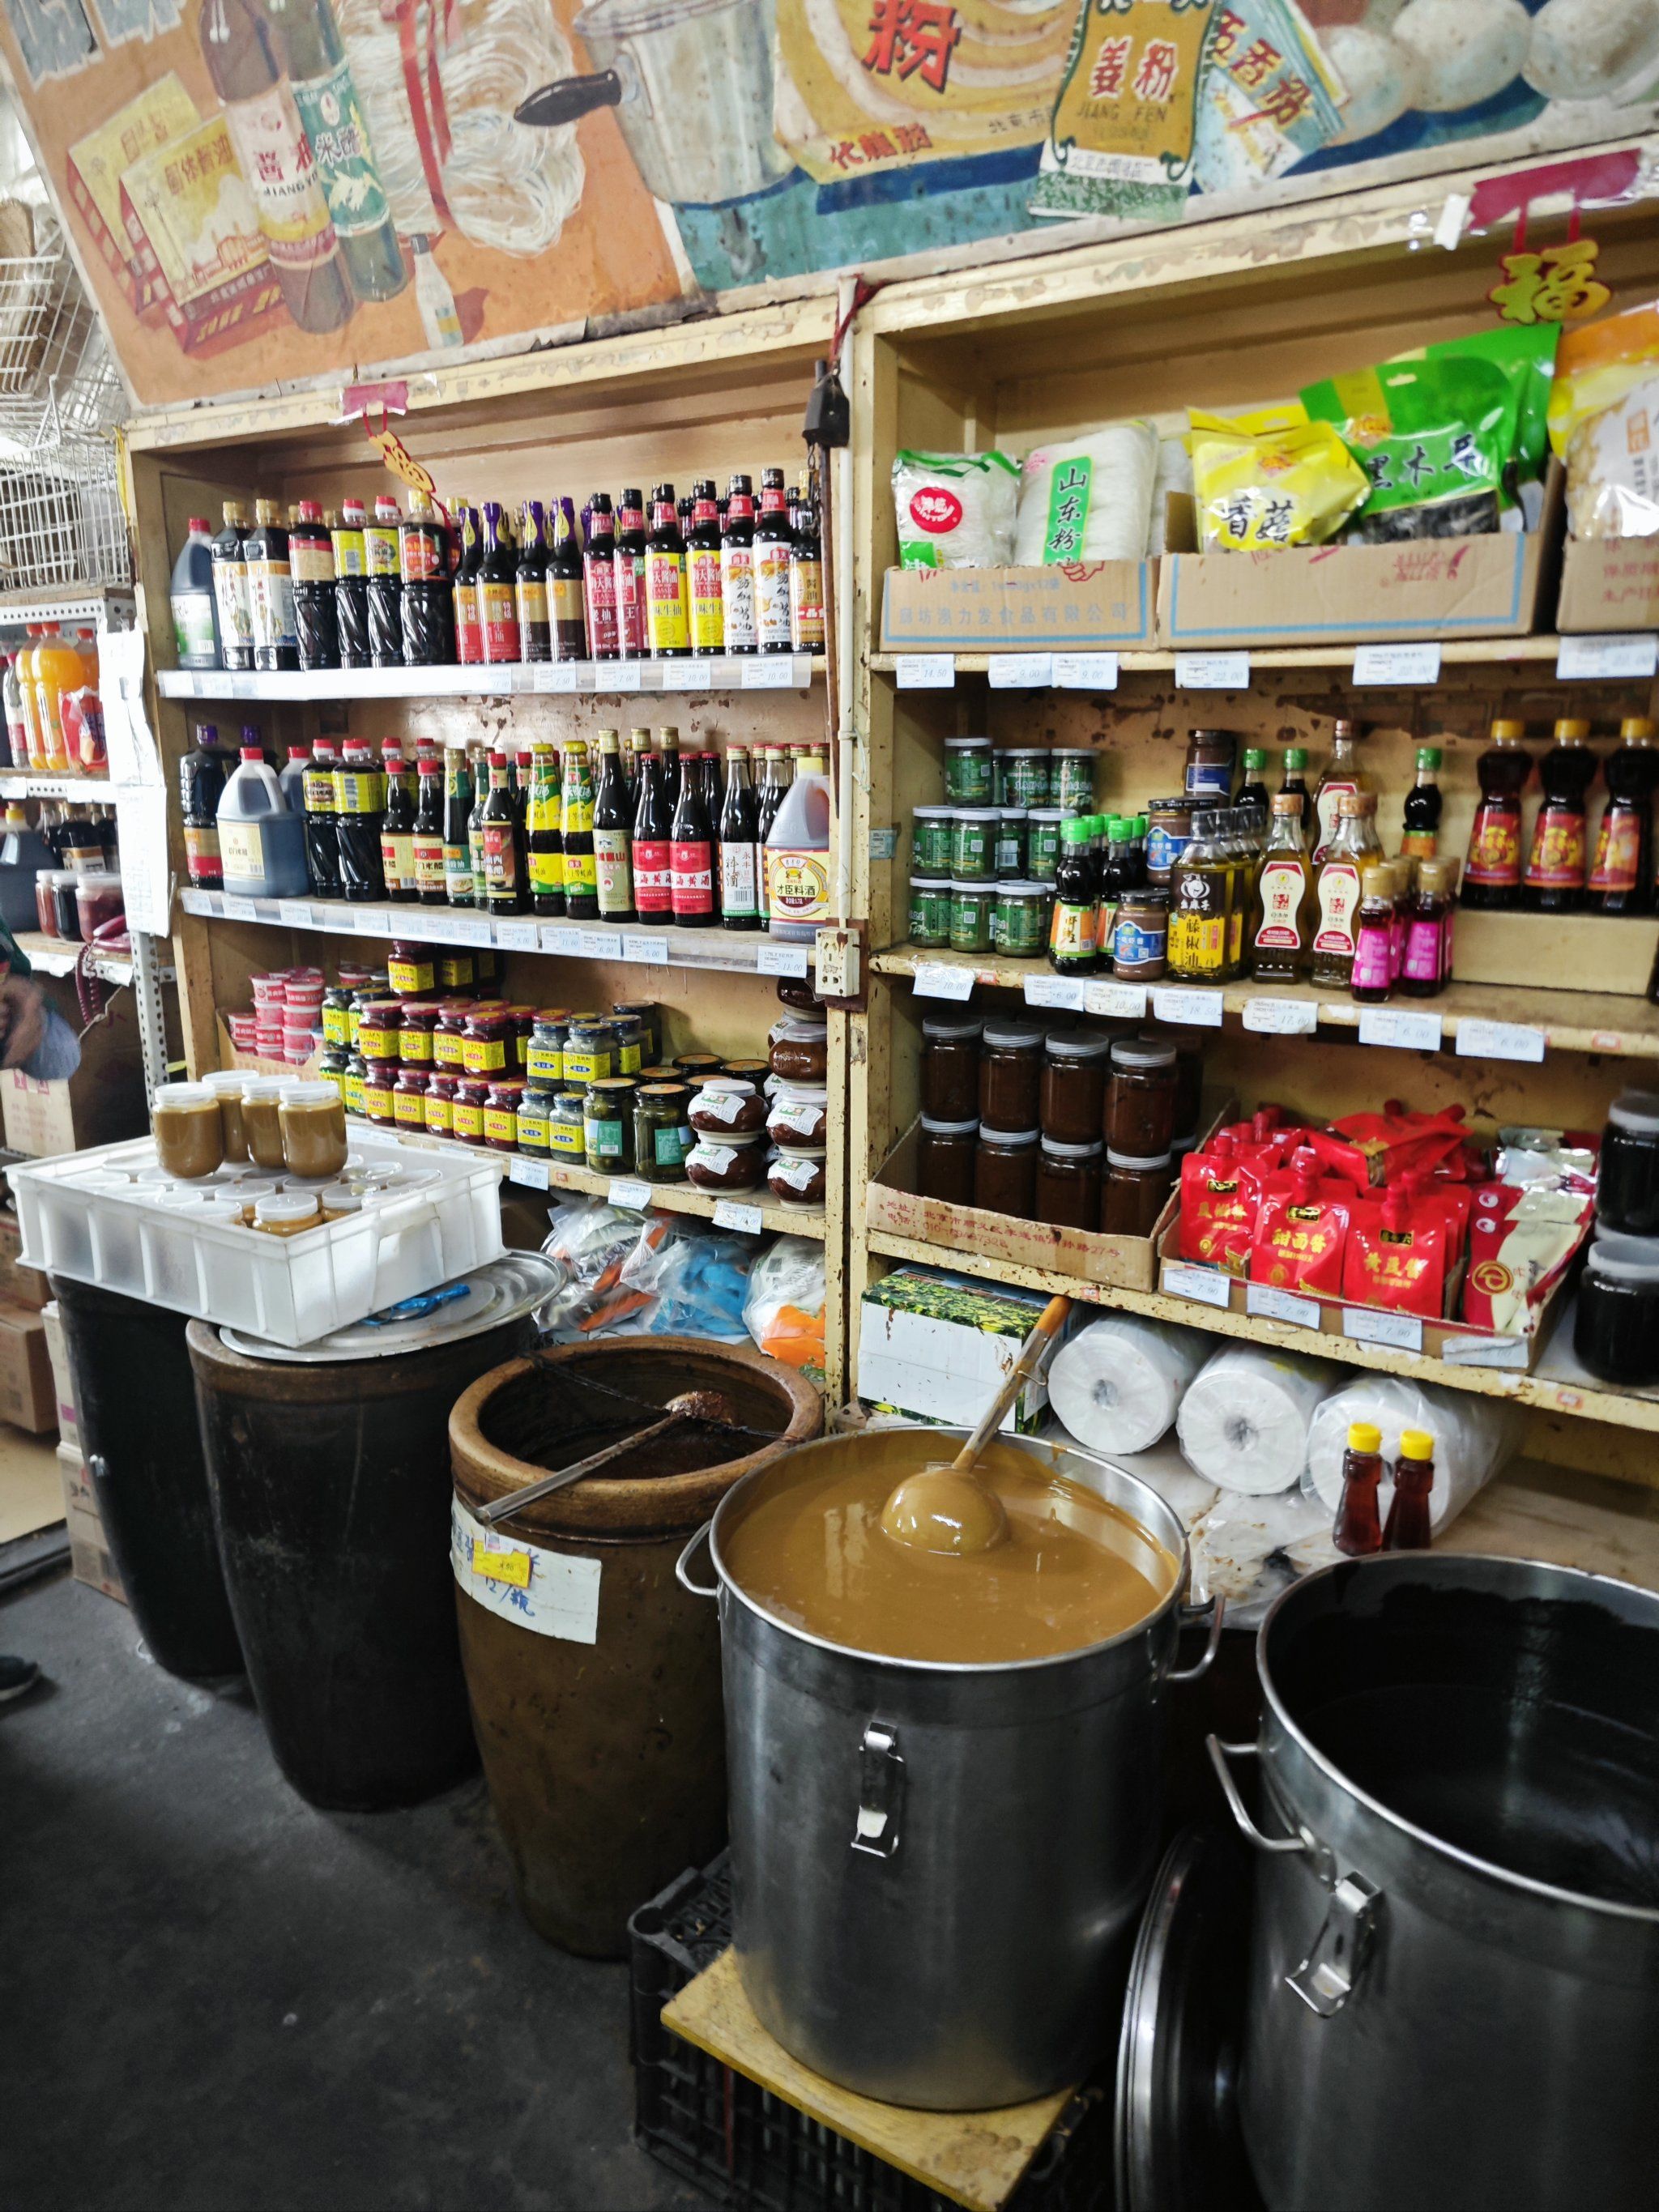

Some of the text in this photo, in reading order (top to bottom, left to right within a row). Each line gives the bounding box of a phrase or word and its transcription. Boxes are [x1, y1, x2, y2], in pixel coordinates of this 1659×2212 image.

[861, 0, 962, 93] 粉
[1092, 39, 1177, 100] 姜粉
[1135, 105, 1168, 123] FEN
[1488, 239, 1613, 324] 福
[671, 873, 710, 886] 海黄酒
[777, 884, 816, 897] 才臣料酒
[1272, 1228, 1327, 1255] 甜面酱
[1364, 1251, 1429, 1280] 黄豆酱
